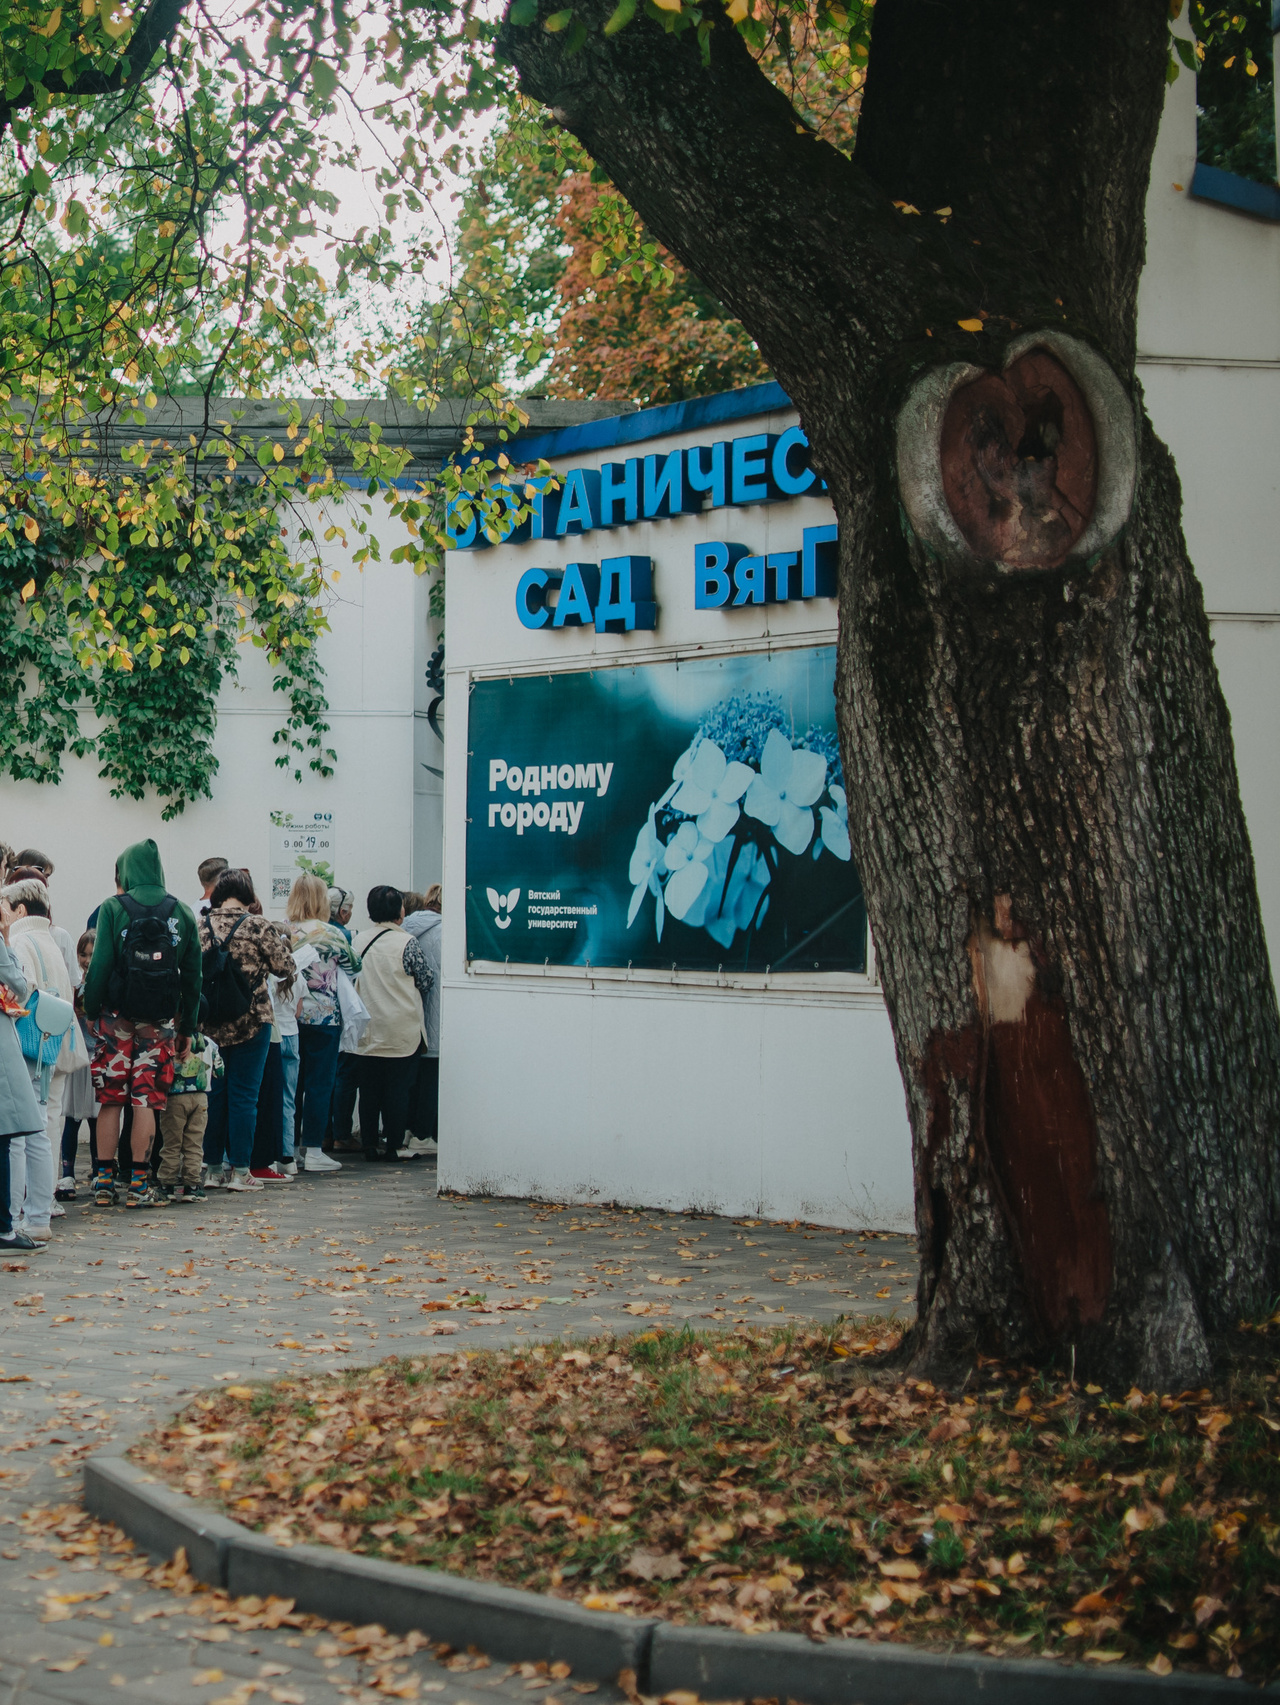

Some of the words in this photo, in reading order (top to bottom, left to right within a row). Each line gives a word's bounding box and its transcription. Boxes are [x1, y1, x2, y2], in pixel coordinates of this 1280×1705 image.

[446, 426, 827, 550] БОТАНИЧЕС
[516, 556, 637, 633] САД
[489, 759, 614, 797] Родному
[488, 801, 585, 835] городу
[528, 890, 560, 900] Вятский
[528, 905, 597, 916] государственный
[528, 920, 578, 930] университет
